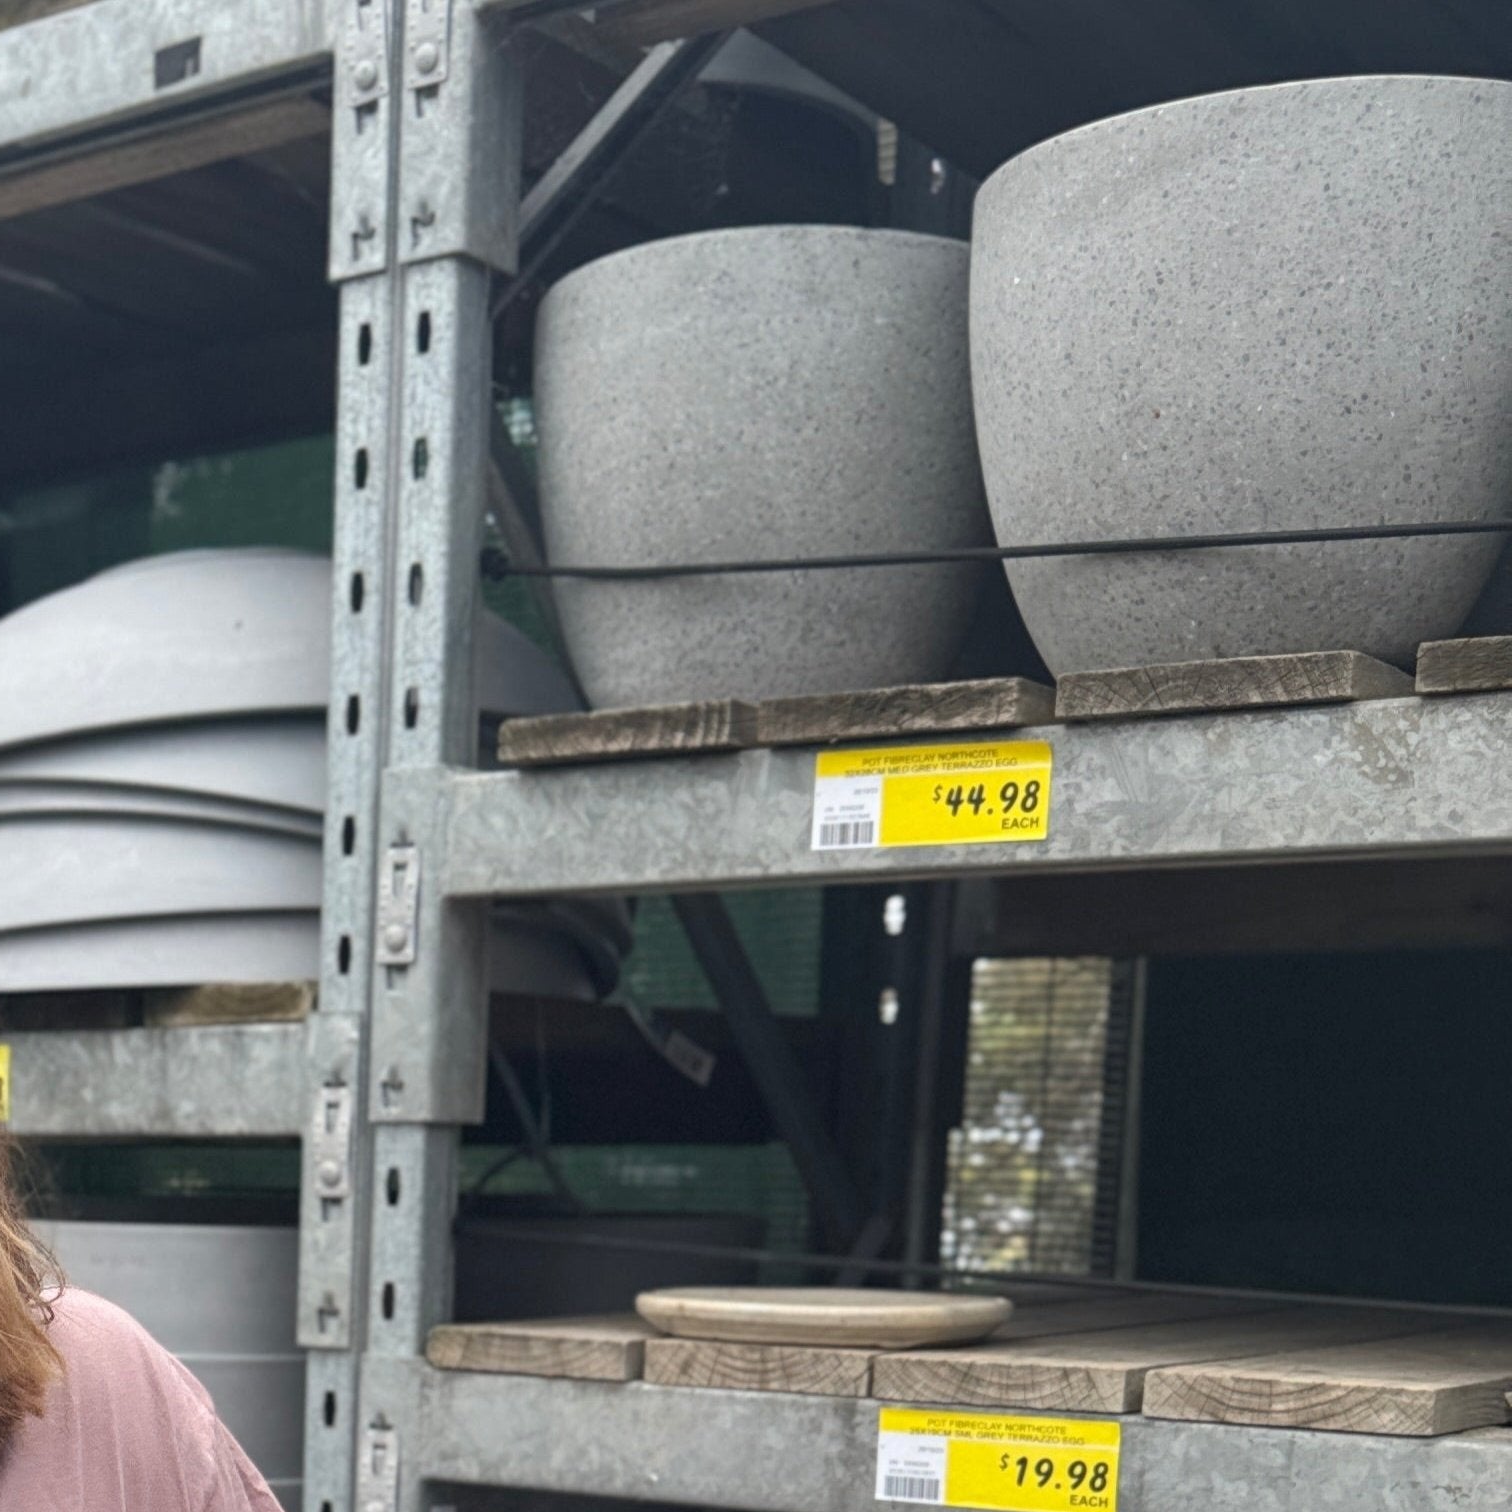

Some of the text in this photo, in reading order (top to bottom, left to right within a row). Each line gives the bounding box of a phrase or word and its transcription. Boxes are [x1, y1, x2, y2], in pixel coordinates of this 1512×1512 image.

[862, 748, 999, 767] POT FIBRECLAY NORTHCOTE
[911, 763, 939, 774] GREY
[942, 759, 993, 771] TERRAZZO
[996, 757, 1018, 768] EGG
[932, 780, 1041, 817] $44.98
[1002, 816, 1040, 830] EACH
[949, 1419, 1002, 1432] FIBRECLAY
[1005, 1423, 1067, 1435] NORTHCOTE
[976, 1430, 1004, 1441] GREY
[1007, 1433, 1060, 1445] TERRAZZO
[999, 1453, 1109, 1493] $19.98
[1069, 1494, 1109, 1508] EACH
